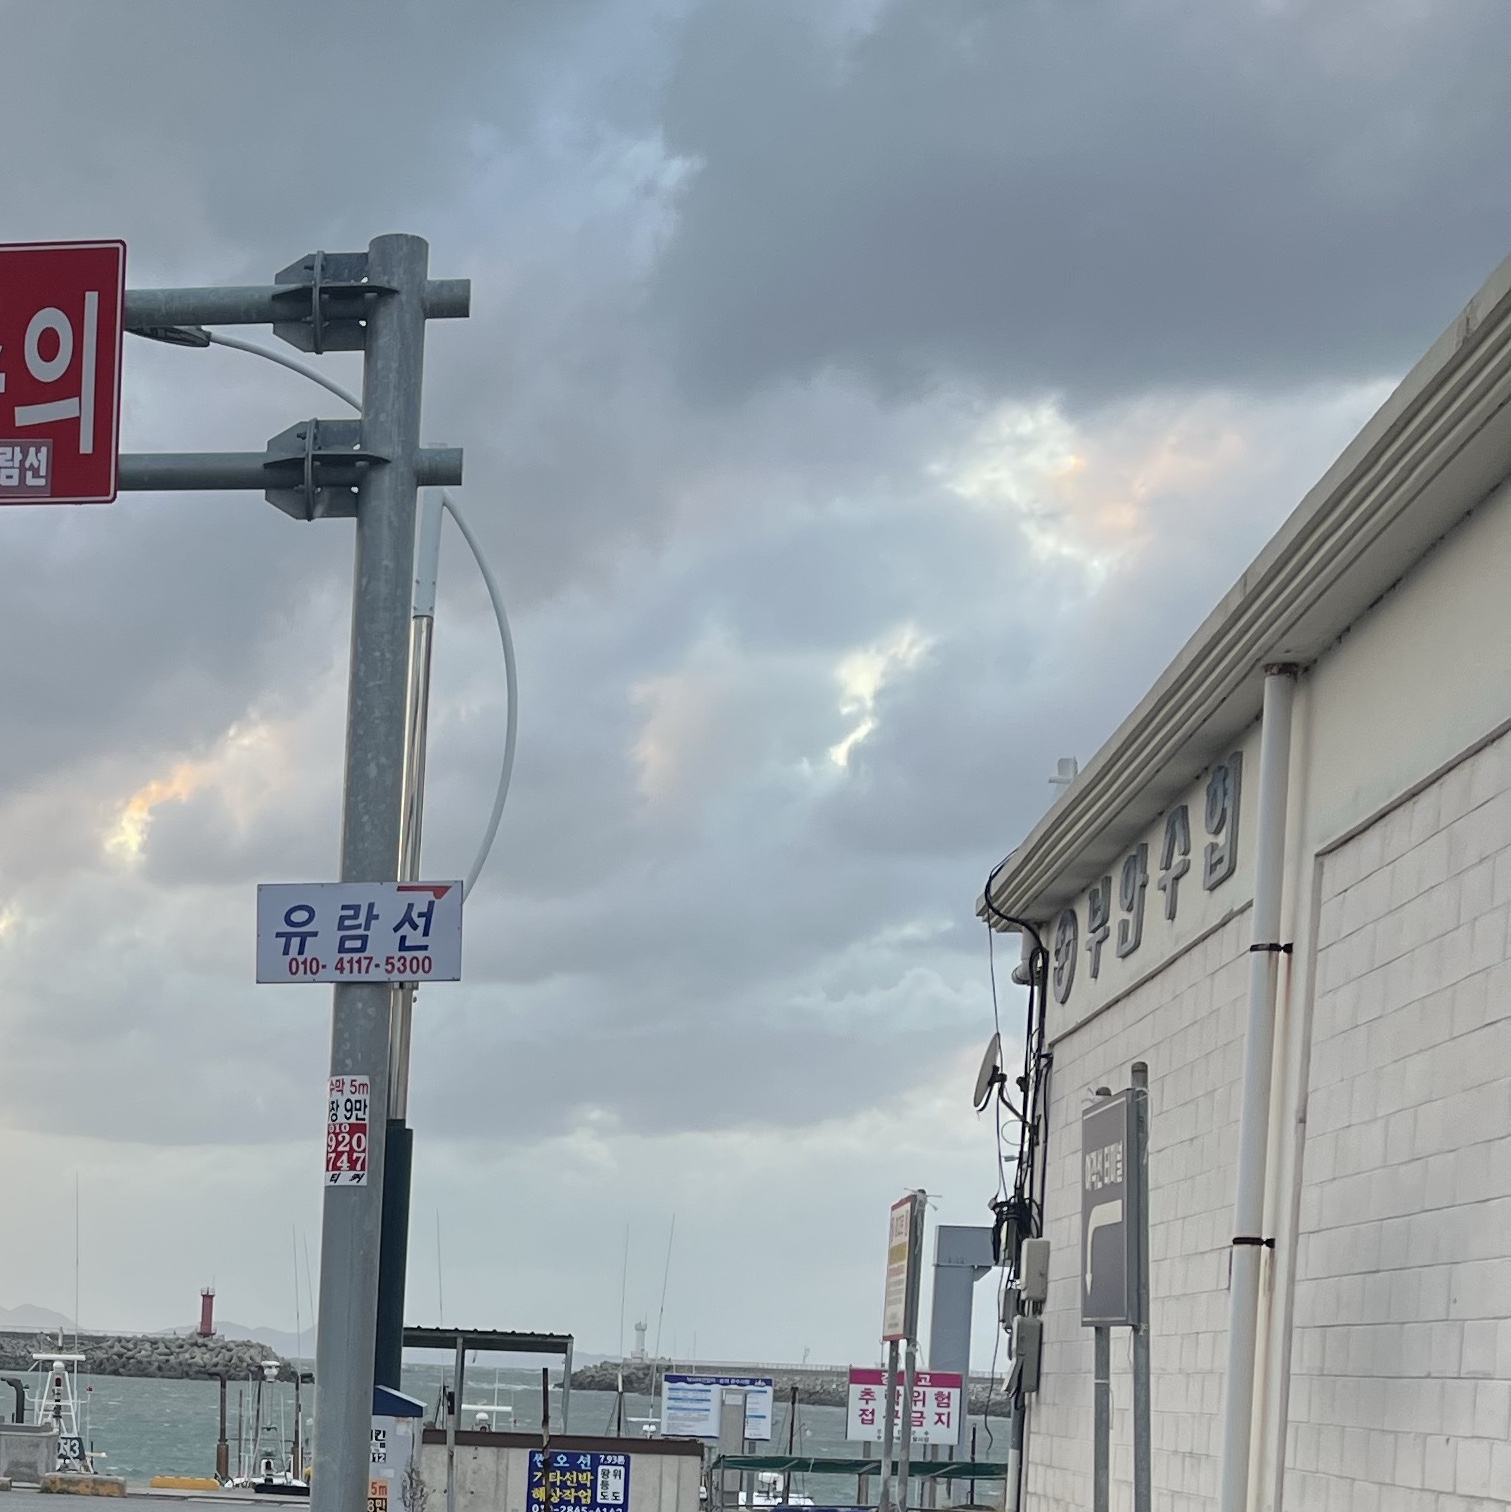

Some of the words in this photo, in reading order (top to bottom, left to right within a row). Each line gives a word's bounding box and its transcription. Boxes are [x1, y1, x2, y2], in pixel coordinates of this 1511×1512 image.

[1086, 751, 1243, 979] 부안수협
[275, 900, 436, 956] 유람선
[350, 1079, 369, 1095] 5m
[344, 1098, 368, 1122] 9만
[371, 1481, 387, 1495] 5m
